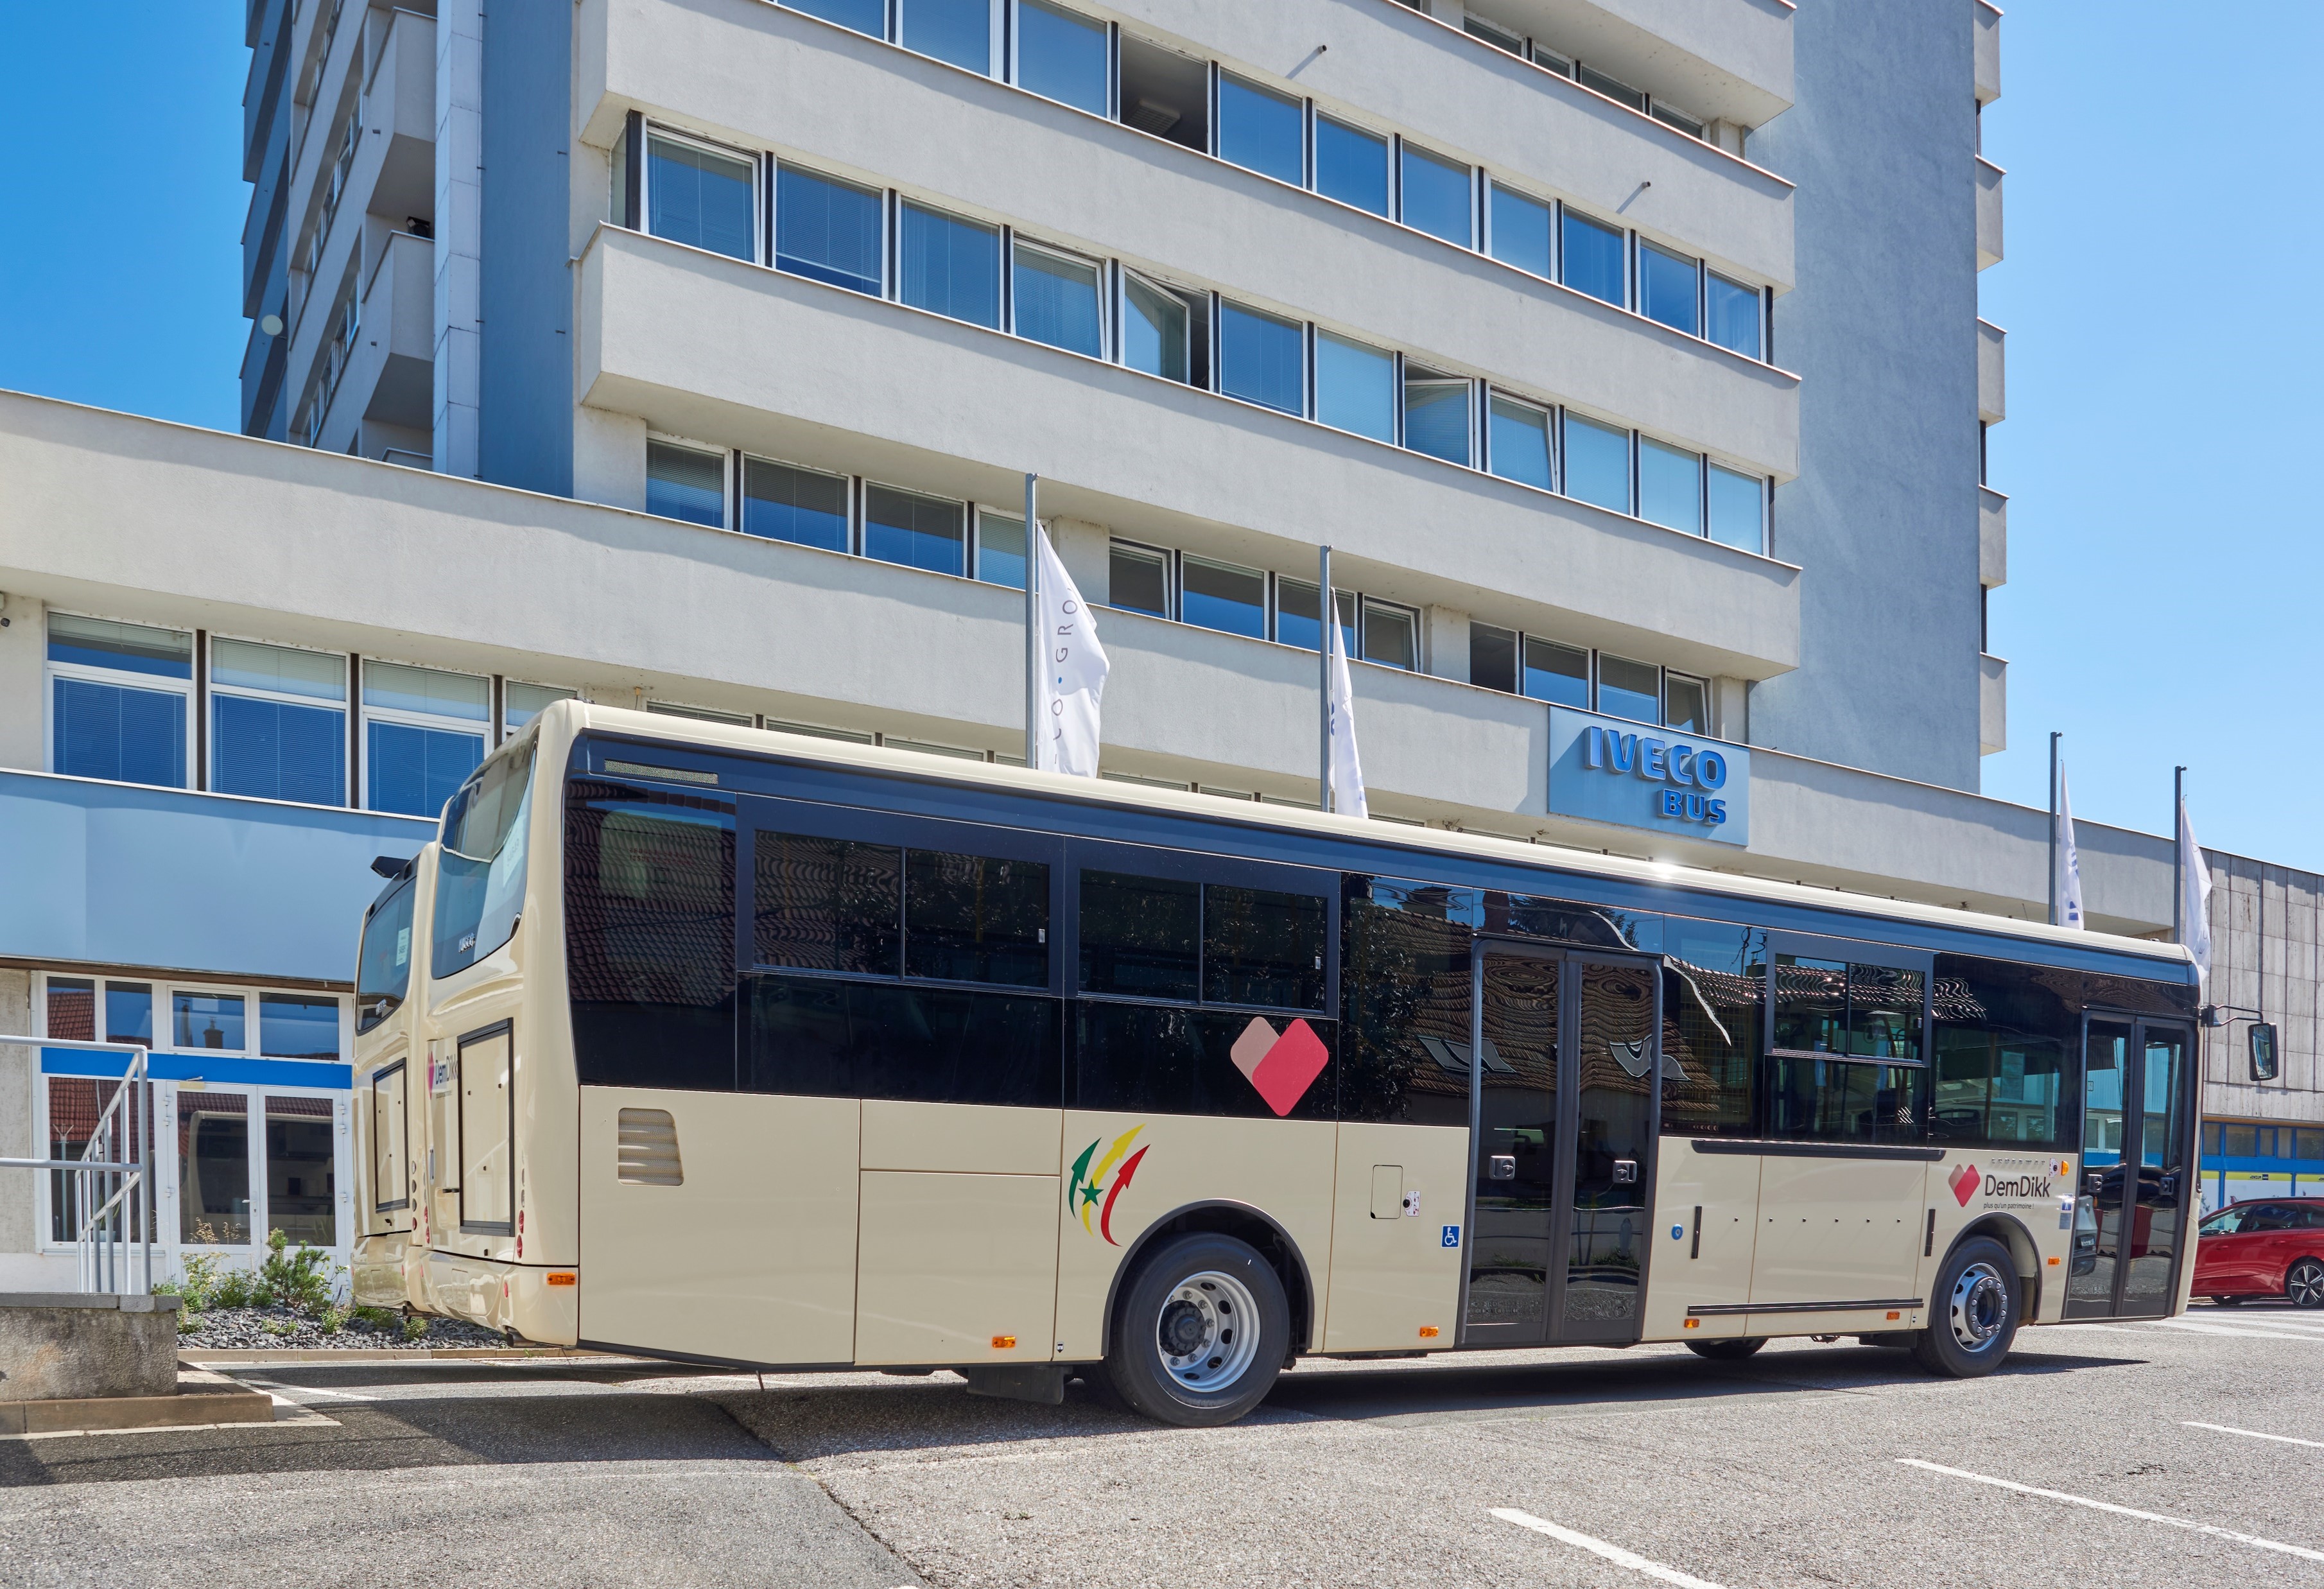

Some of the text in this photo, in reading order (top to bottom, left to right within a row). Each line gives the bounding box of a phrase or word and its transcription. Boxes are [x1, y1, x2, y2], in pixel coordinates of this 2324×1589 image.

[1584, 725, 1727, 792] IVECO
[1658, 789, 1726, 826] BUS
[1984, 1174, 2051, 1198] DemDikk
